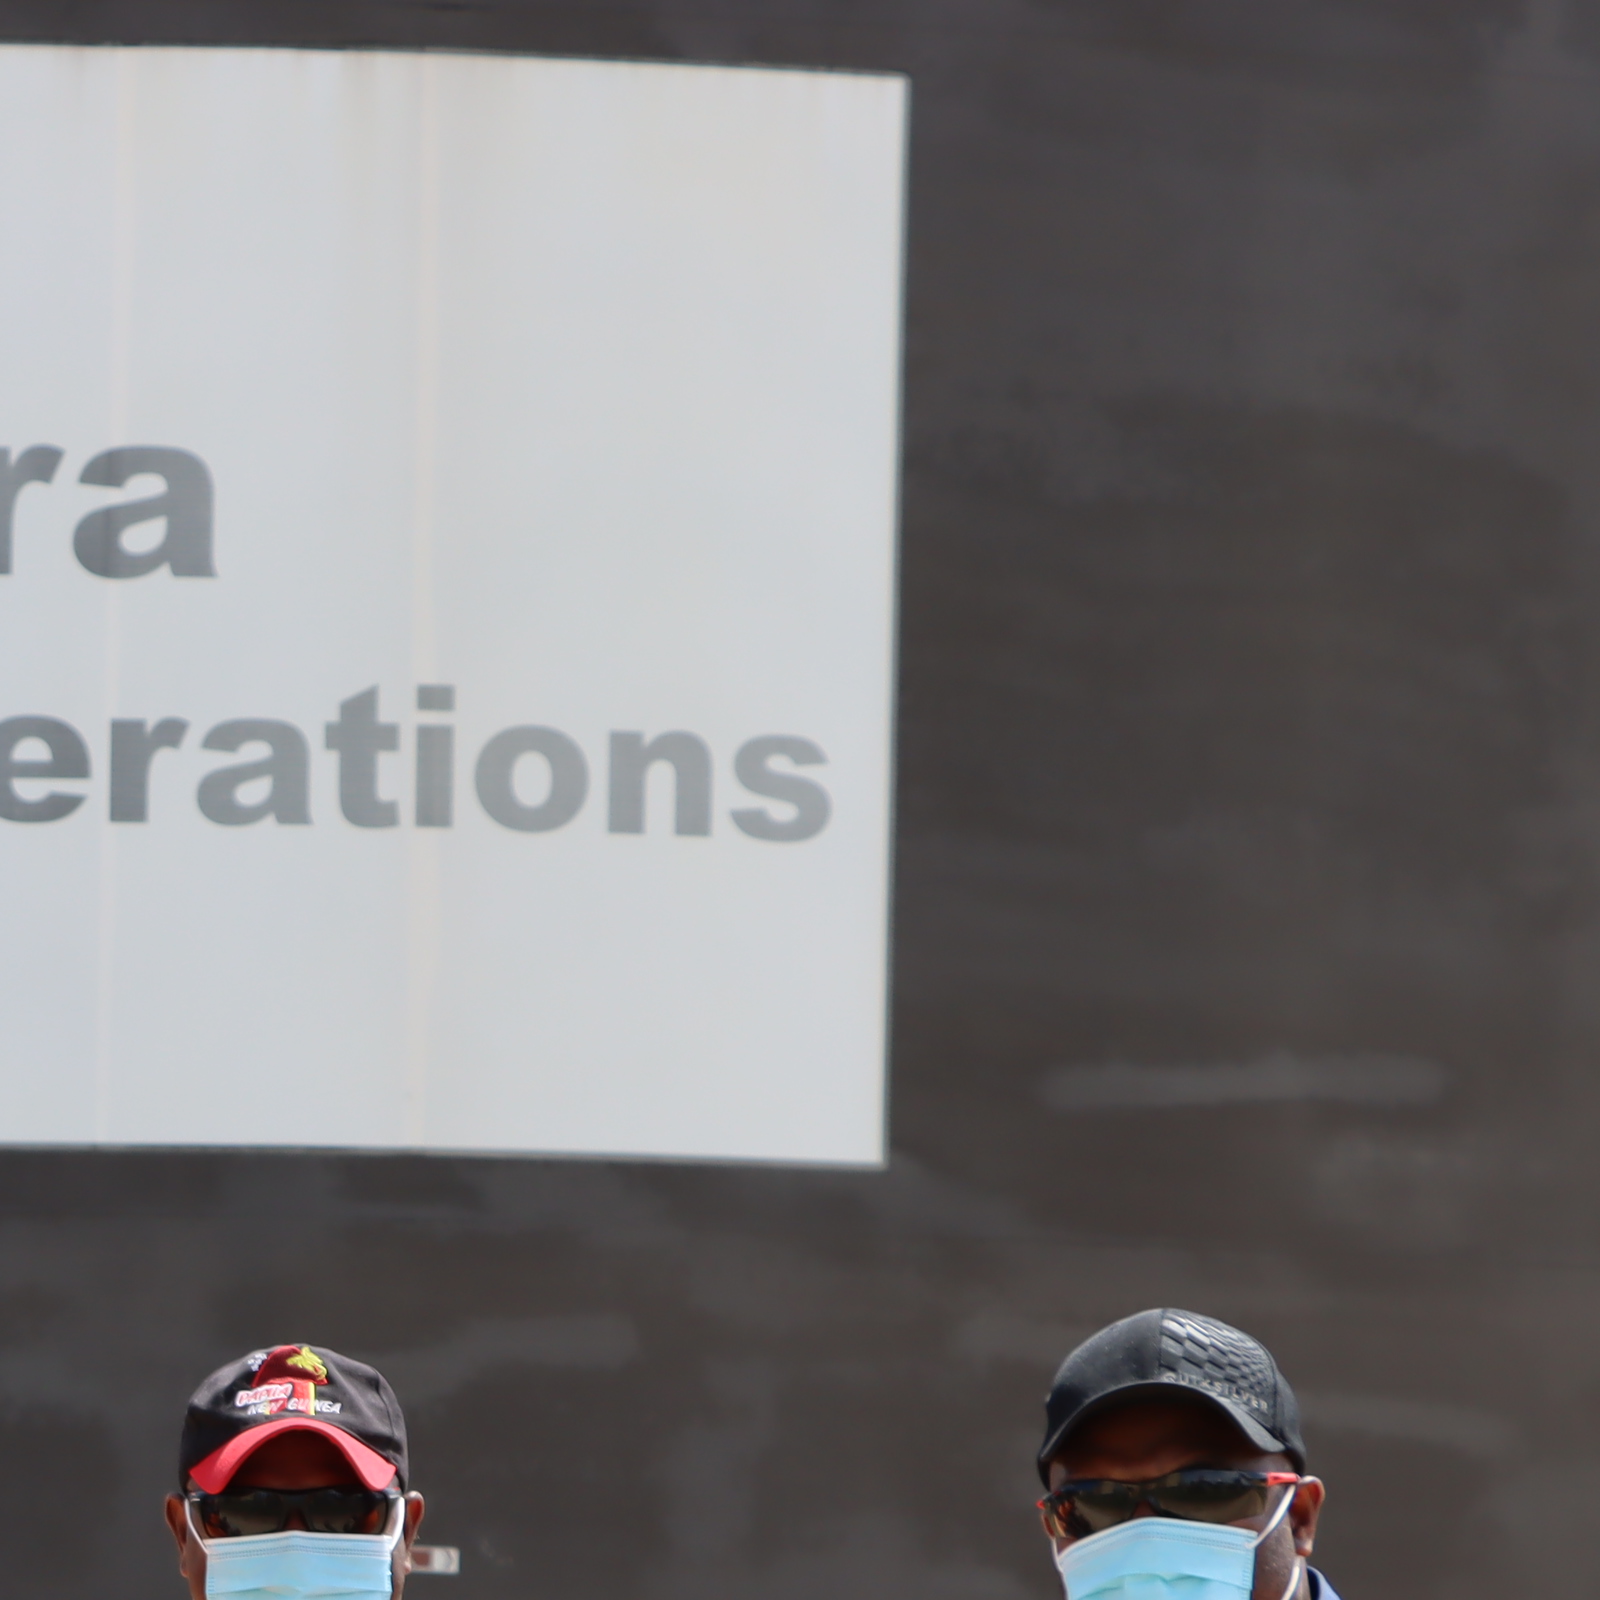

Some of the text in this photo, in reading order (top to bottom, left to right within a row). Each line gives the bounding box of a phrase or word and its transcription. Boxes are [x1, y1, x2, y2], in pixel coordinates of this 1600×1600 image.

[235, 1383, 293, 1407] PAPUA
[247, 1398, 342, 1416] NEW GUINEA
